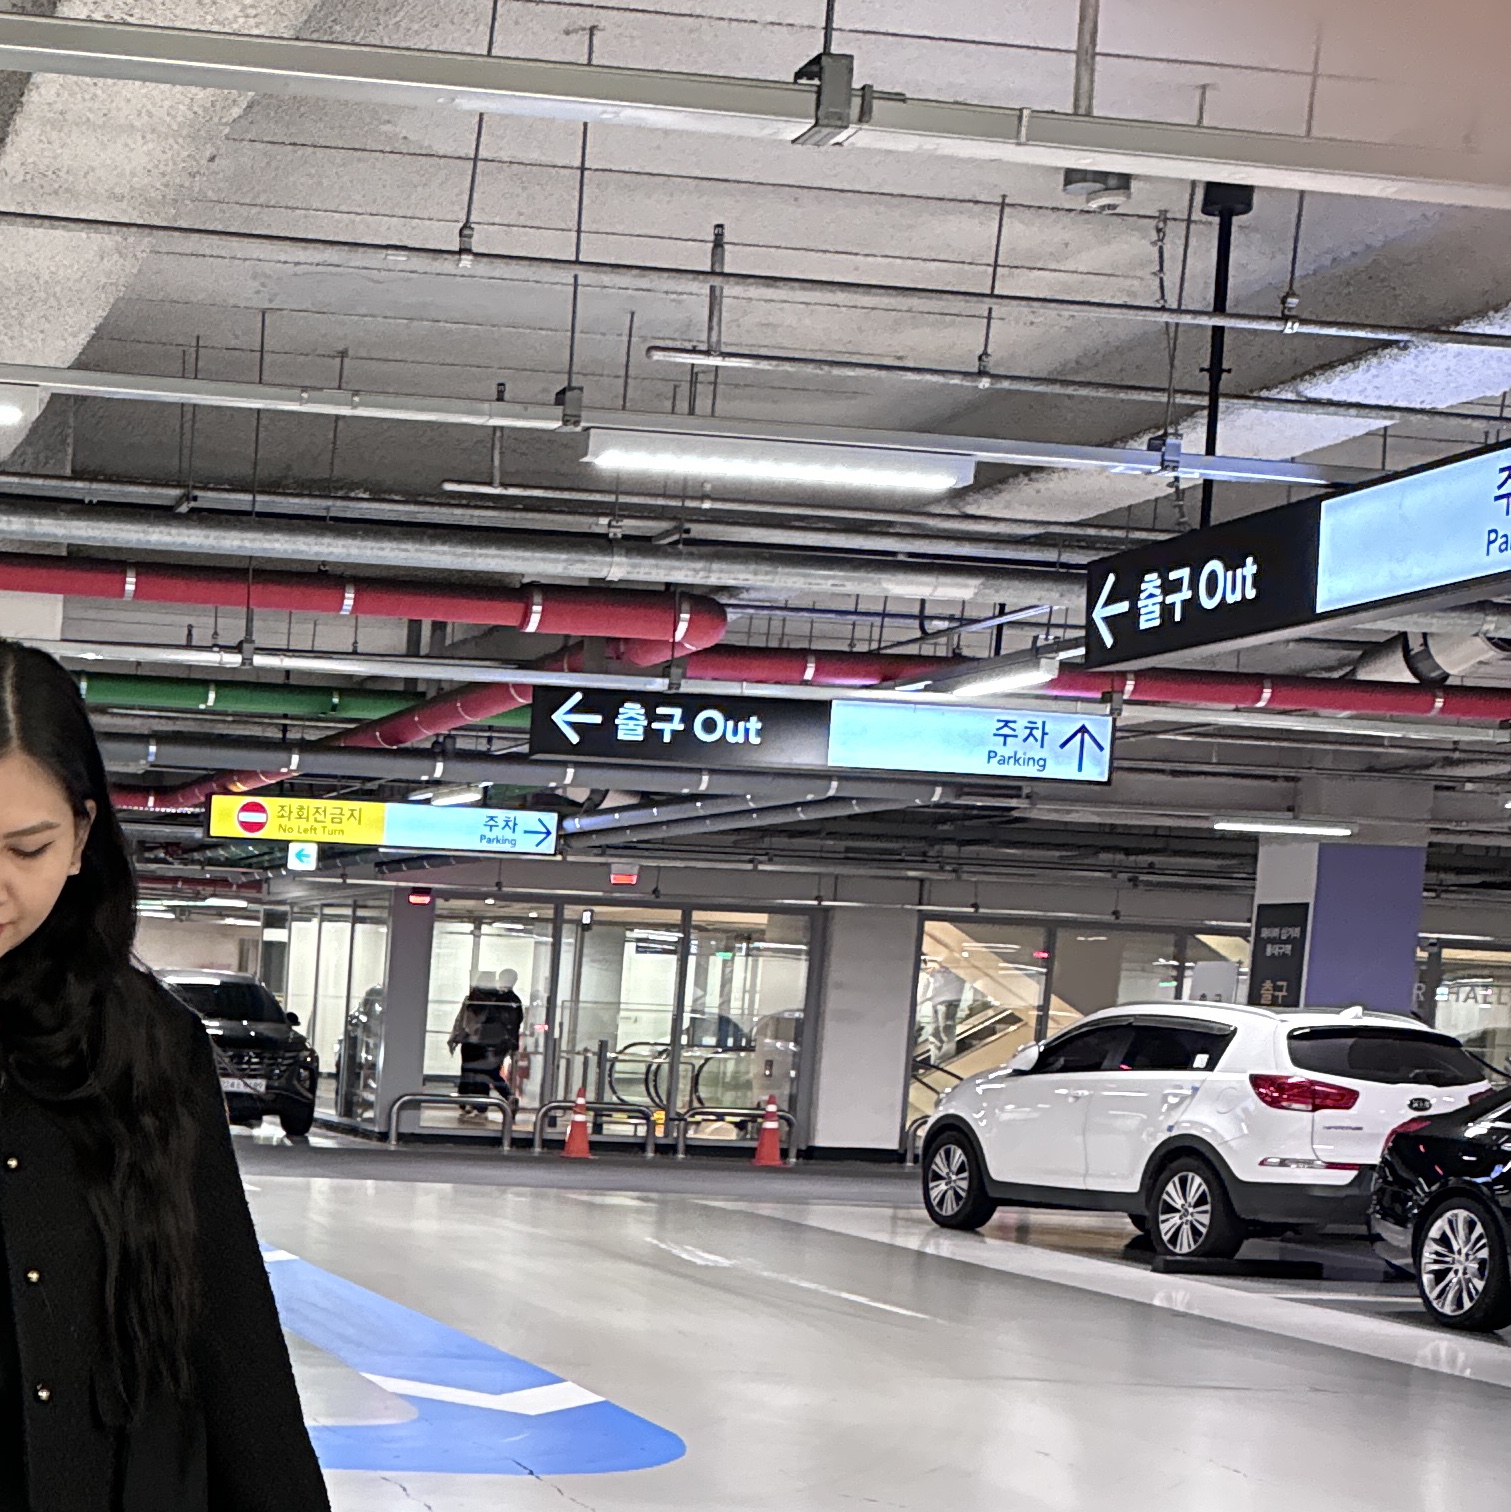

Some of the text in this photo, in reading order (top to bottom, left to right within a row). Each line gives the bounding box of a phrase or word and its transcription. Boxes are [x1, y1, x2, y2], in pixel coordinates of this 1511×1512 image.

[1486, 529, 1511, 556] Pa
[1137, 556, 1257, 630] 출구 Out
[614, 701, 763, 745] 출구 Out
[992, 718, 1050, 749] 주차
[987, 749, 1048, 773] Parking
[276, 803, 363, 826] 좌회전금지
[482, 814, 519, 834] 주차
[277, 823, 345, 837] No Left Turn
[479, 833, 517, 849] Parking
[1260, 979, 1289, 1005] 출구
